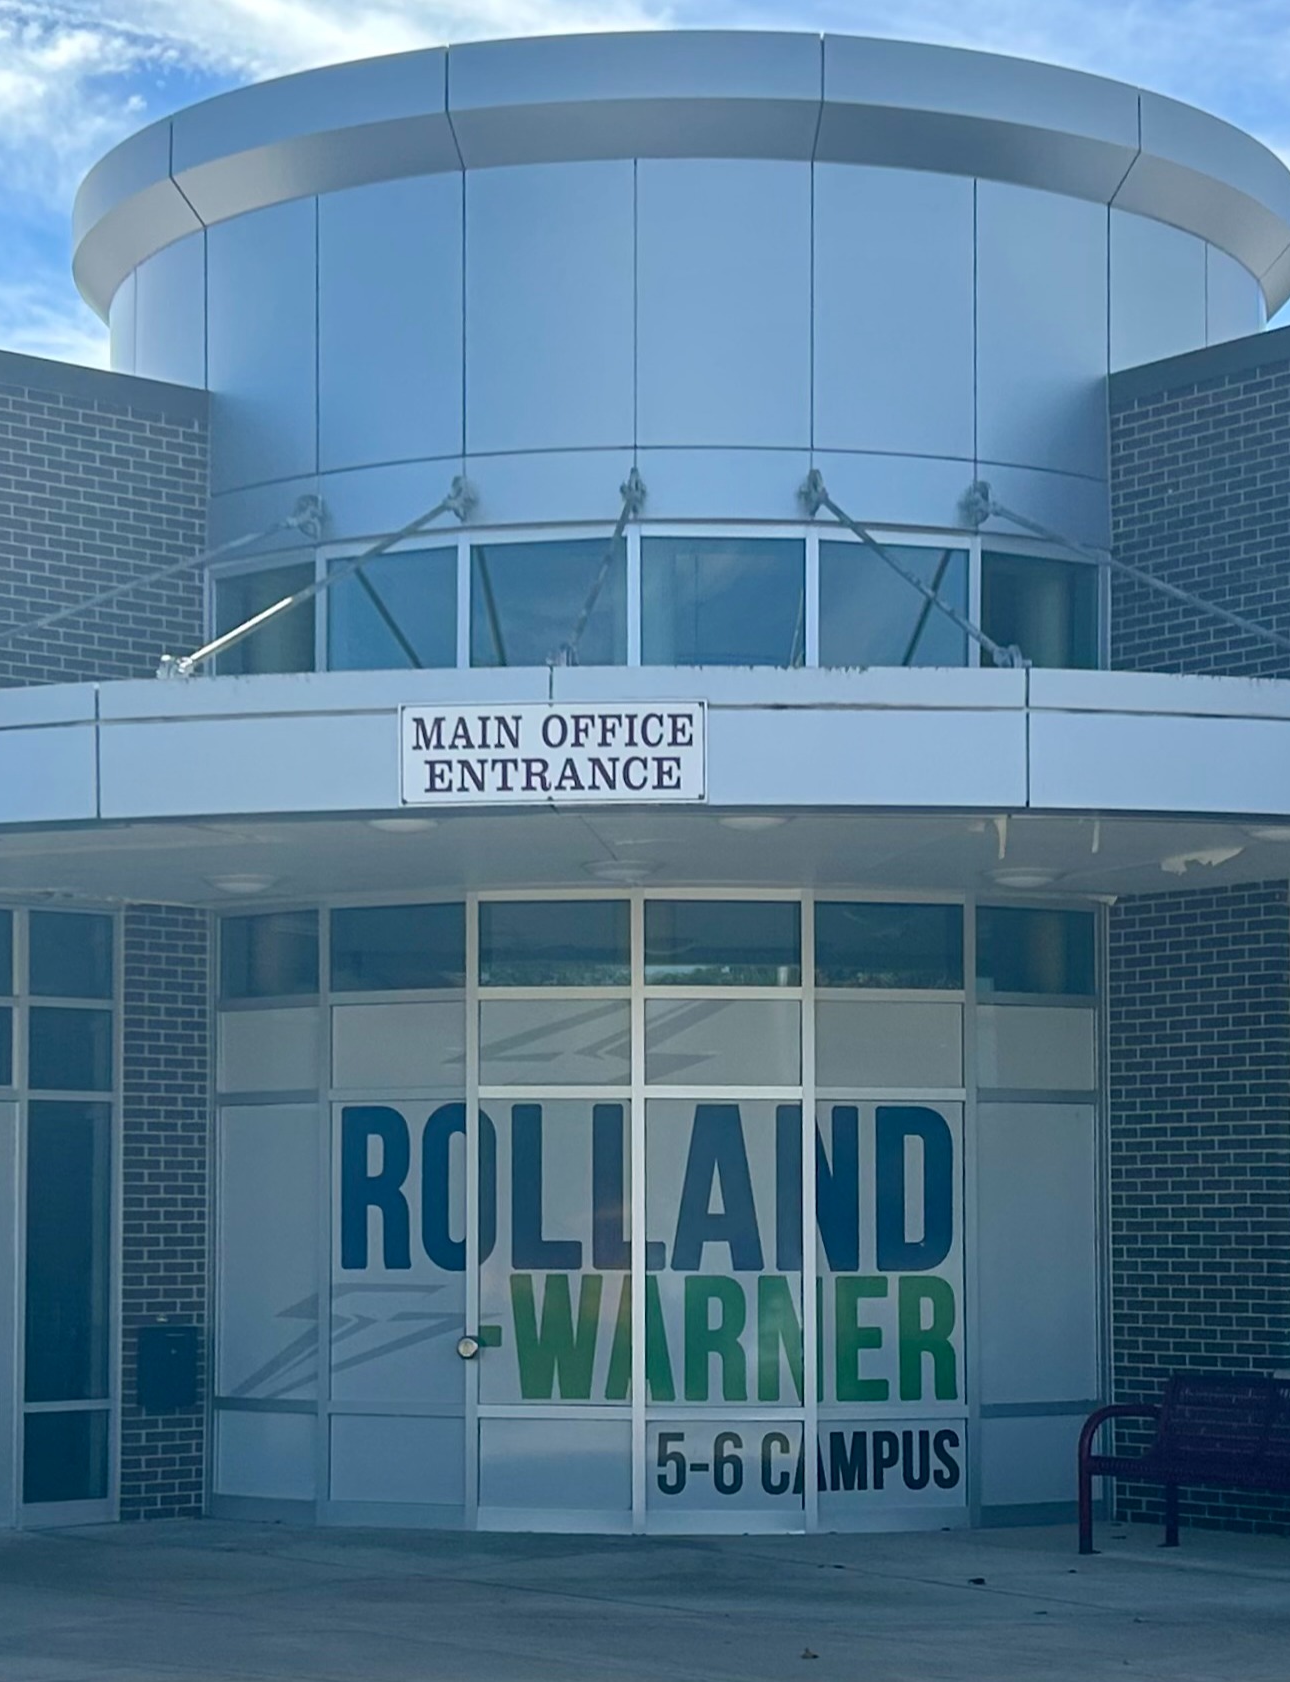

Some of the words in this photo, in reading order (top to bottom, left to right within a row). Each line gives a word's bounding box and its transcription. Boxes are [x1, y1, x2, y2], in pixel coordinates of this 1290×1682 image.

[412, 715, 522, 750] MAIN
[541, 712, 693, 748] OFFICE
[424, 756, 682, 793] ENTRANCE
[341, 1102, 953, 1272] ROLLAND
[656, 1431, 744, 1495] 5-6
[761, 1429, 960, 1495] CAMPUS
